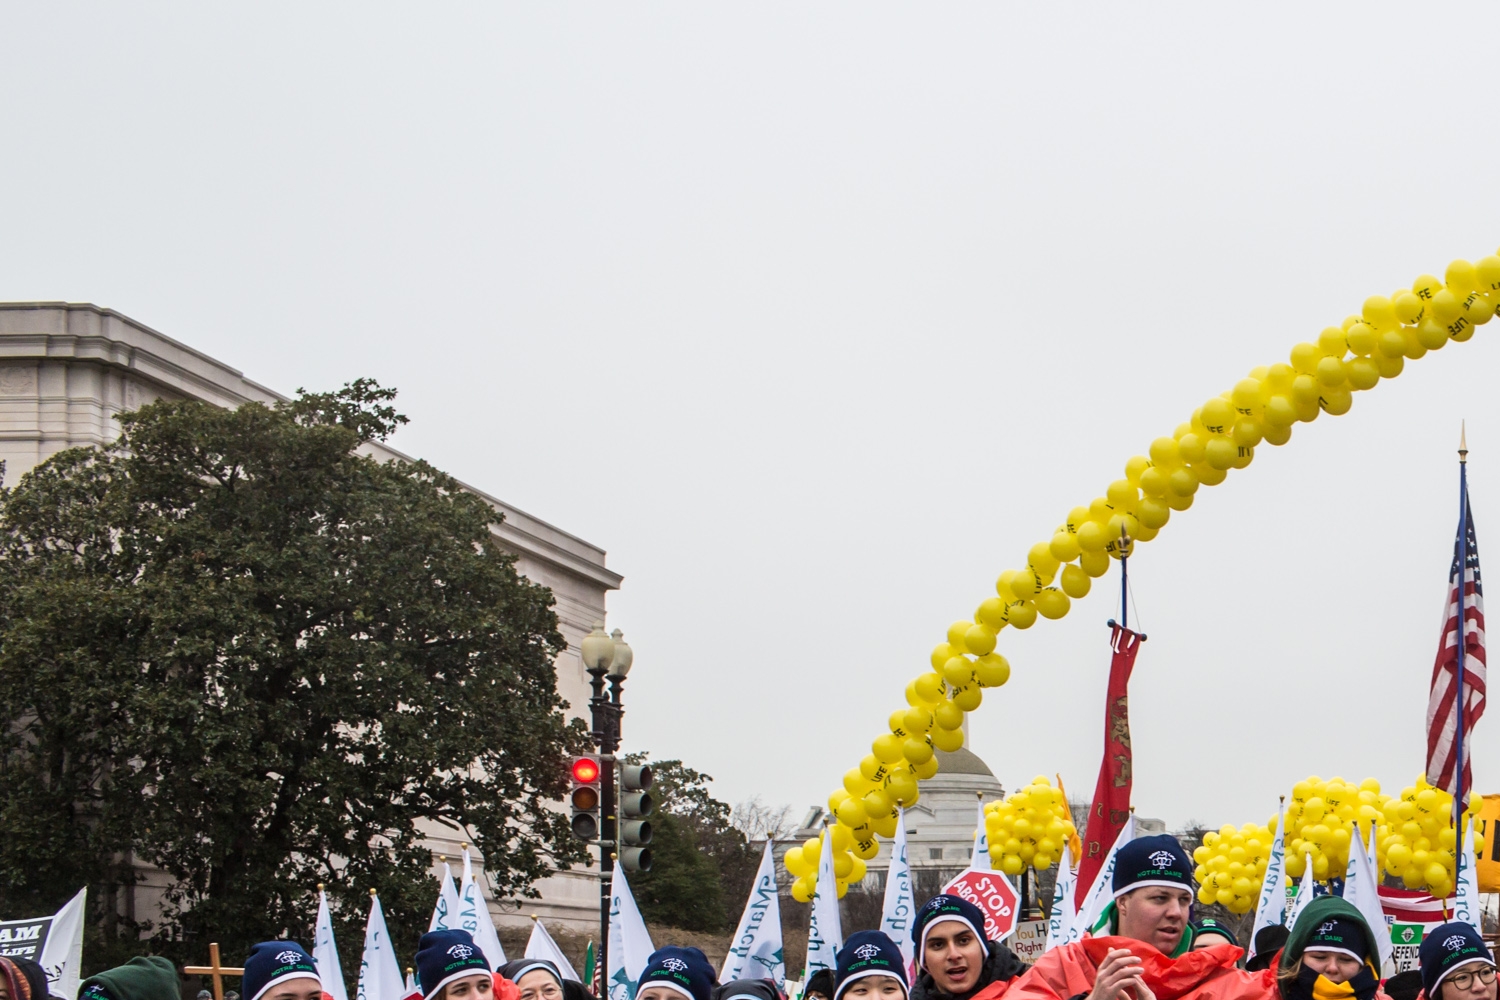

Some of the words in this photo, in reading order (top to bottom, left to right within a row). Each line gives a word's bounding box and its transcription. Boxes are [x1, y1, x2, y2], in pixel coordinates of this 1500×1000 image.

[1137, 869, 1161, 878] NOTRE
[1163, 870, 1183, 879] DAME
[975, 877, 1012, 917] STOP
[1015, 925, 1035, 940] You
[1015, 940, 1043, 956] Right
